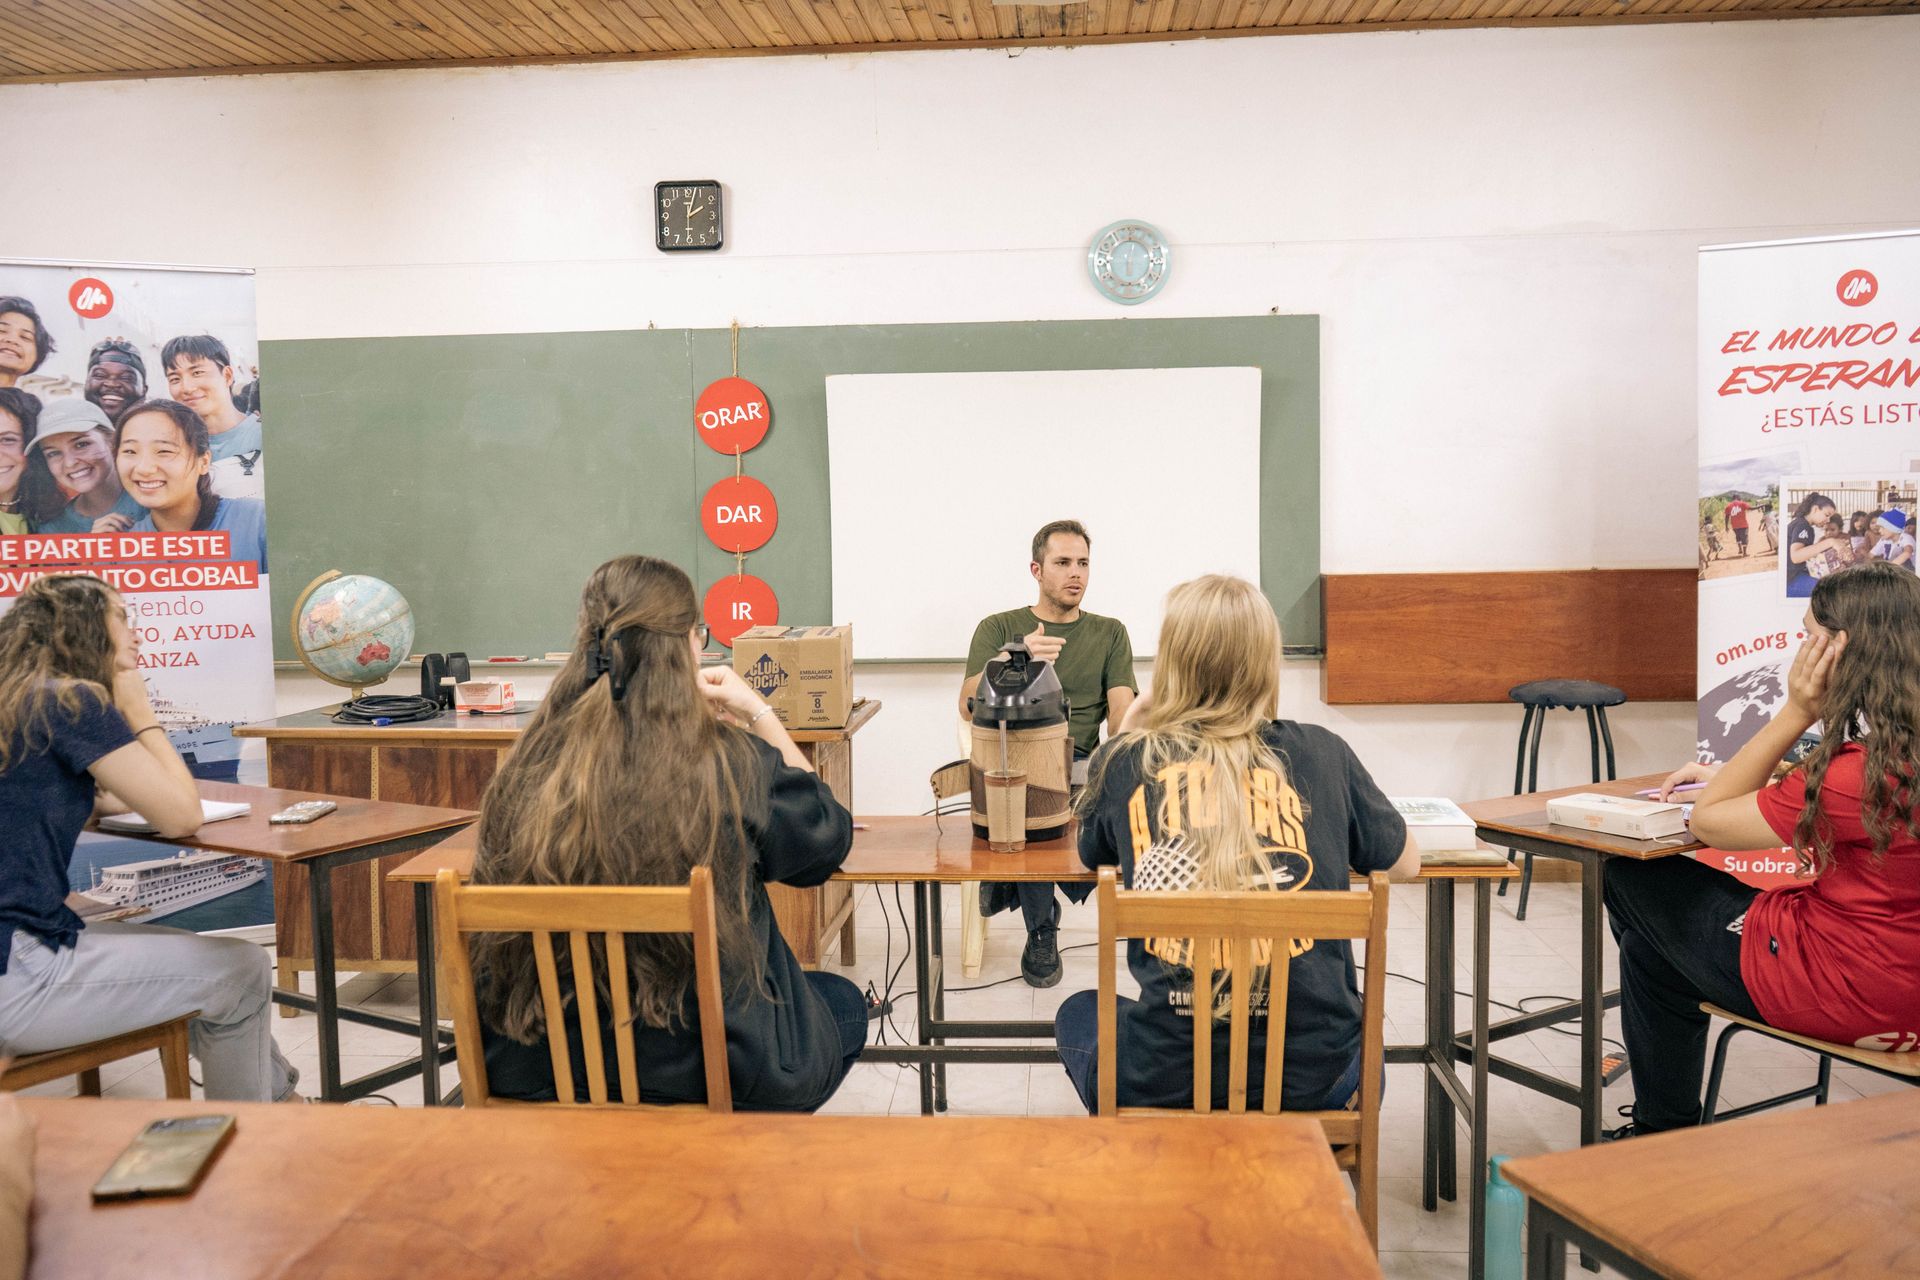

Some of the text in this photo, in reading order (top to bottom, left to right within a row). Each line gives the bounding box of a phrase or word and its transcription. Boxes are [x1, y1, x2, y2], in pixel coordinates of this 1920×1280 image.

[672, 189, 679, 198] 11
[662, 198, 671, 208] 10
[662, 212, 670, 221] 9
[709, 211, 716, 220] 3
[663, 226, 670, 236] 8
[708, 226, 715, 234] 4
[674, 234, 680, 244] 7
[686, 234, 693, 244] 6
[699, 234, 706, 243] 5
[1721, 329, 1760, 354] EL
[1767, 321, 1898, 352] MUNDO
[702, 401, 763, 430] ORAR
[1761, 401, 1920, 433] ¿ESTÁS LIST
[716, 505, 763, 524] DAR
[0, 535, 225, 561] E PARTE DE ESTE
[149, 565, 254, 586] GLOBAL
[731, 602, 753, 621] IR
[173, 623, 256, 642] AYUDA
[1715, 630, 1788, 666] om.org
[749, 660, 780, 676] CLUB
[814, 697, 821, 709] 8
[1724, 856, 1747, 873] Su
[1751, 856, 1796, 874] obra
